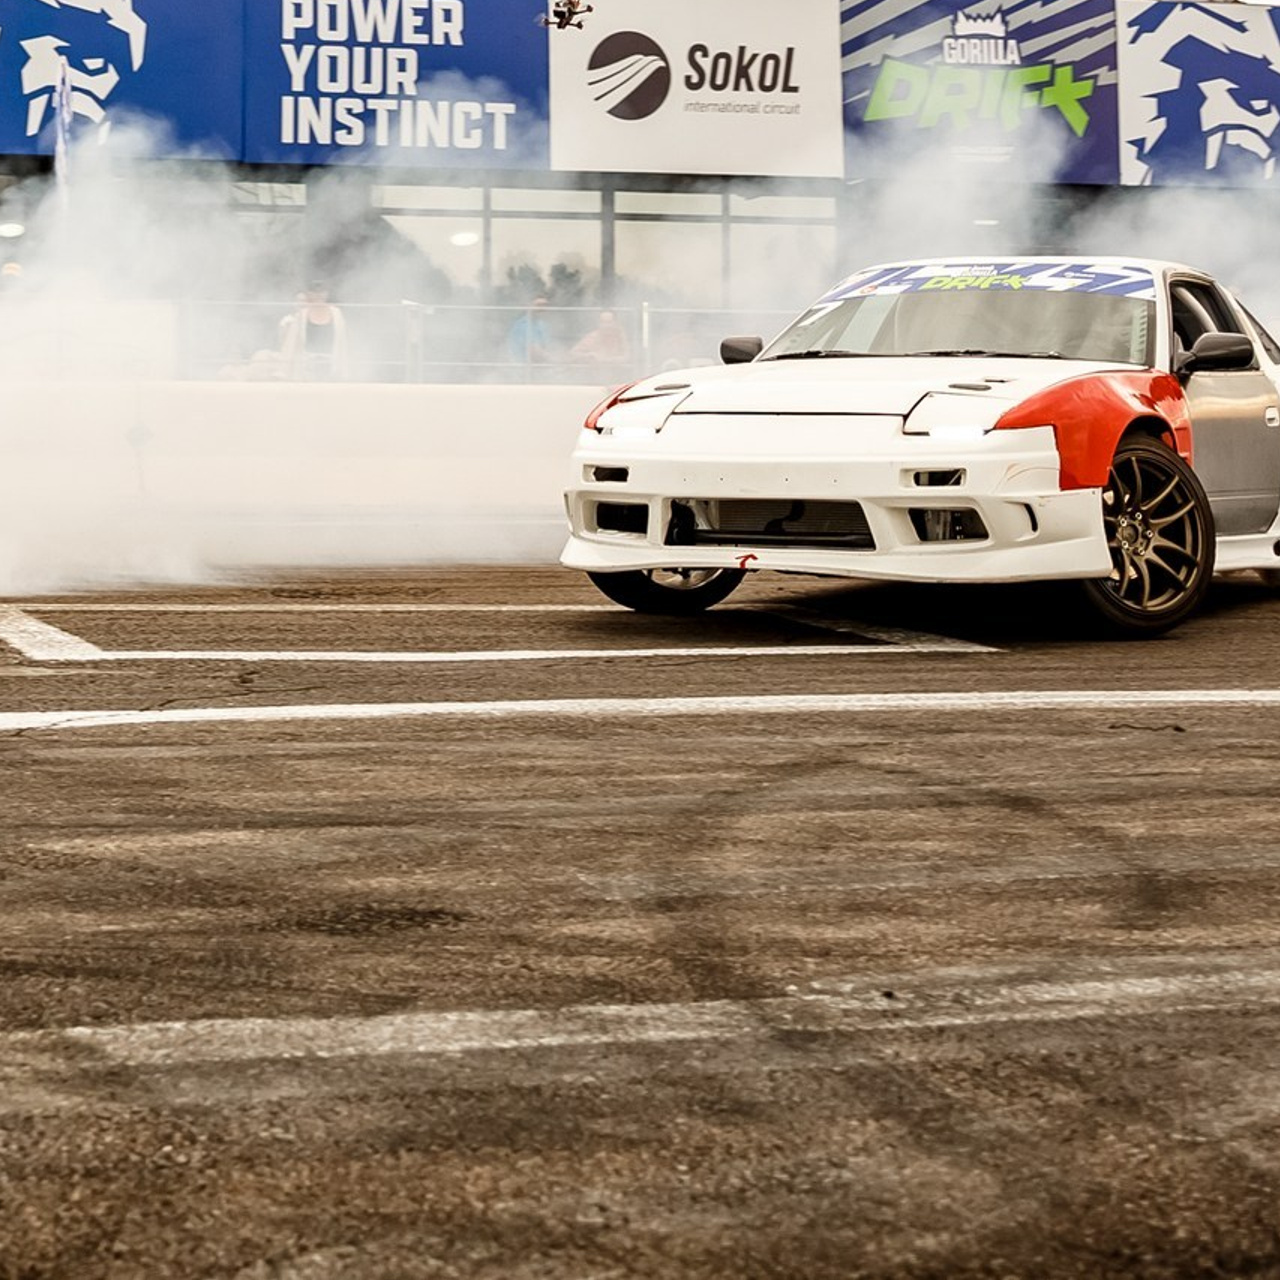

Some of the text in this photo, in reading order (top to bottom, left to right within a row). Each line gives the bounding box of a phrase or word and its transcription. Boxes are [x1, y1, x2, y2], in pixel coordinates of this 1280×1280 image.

[280, 44, 418, 96] YOUR
[942, 38, 1022, 65] GORILLA
[280, 96, 517, 150] INSTINCT
[683, 101, 802, 116] international circuit
